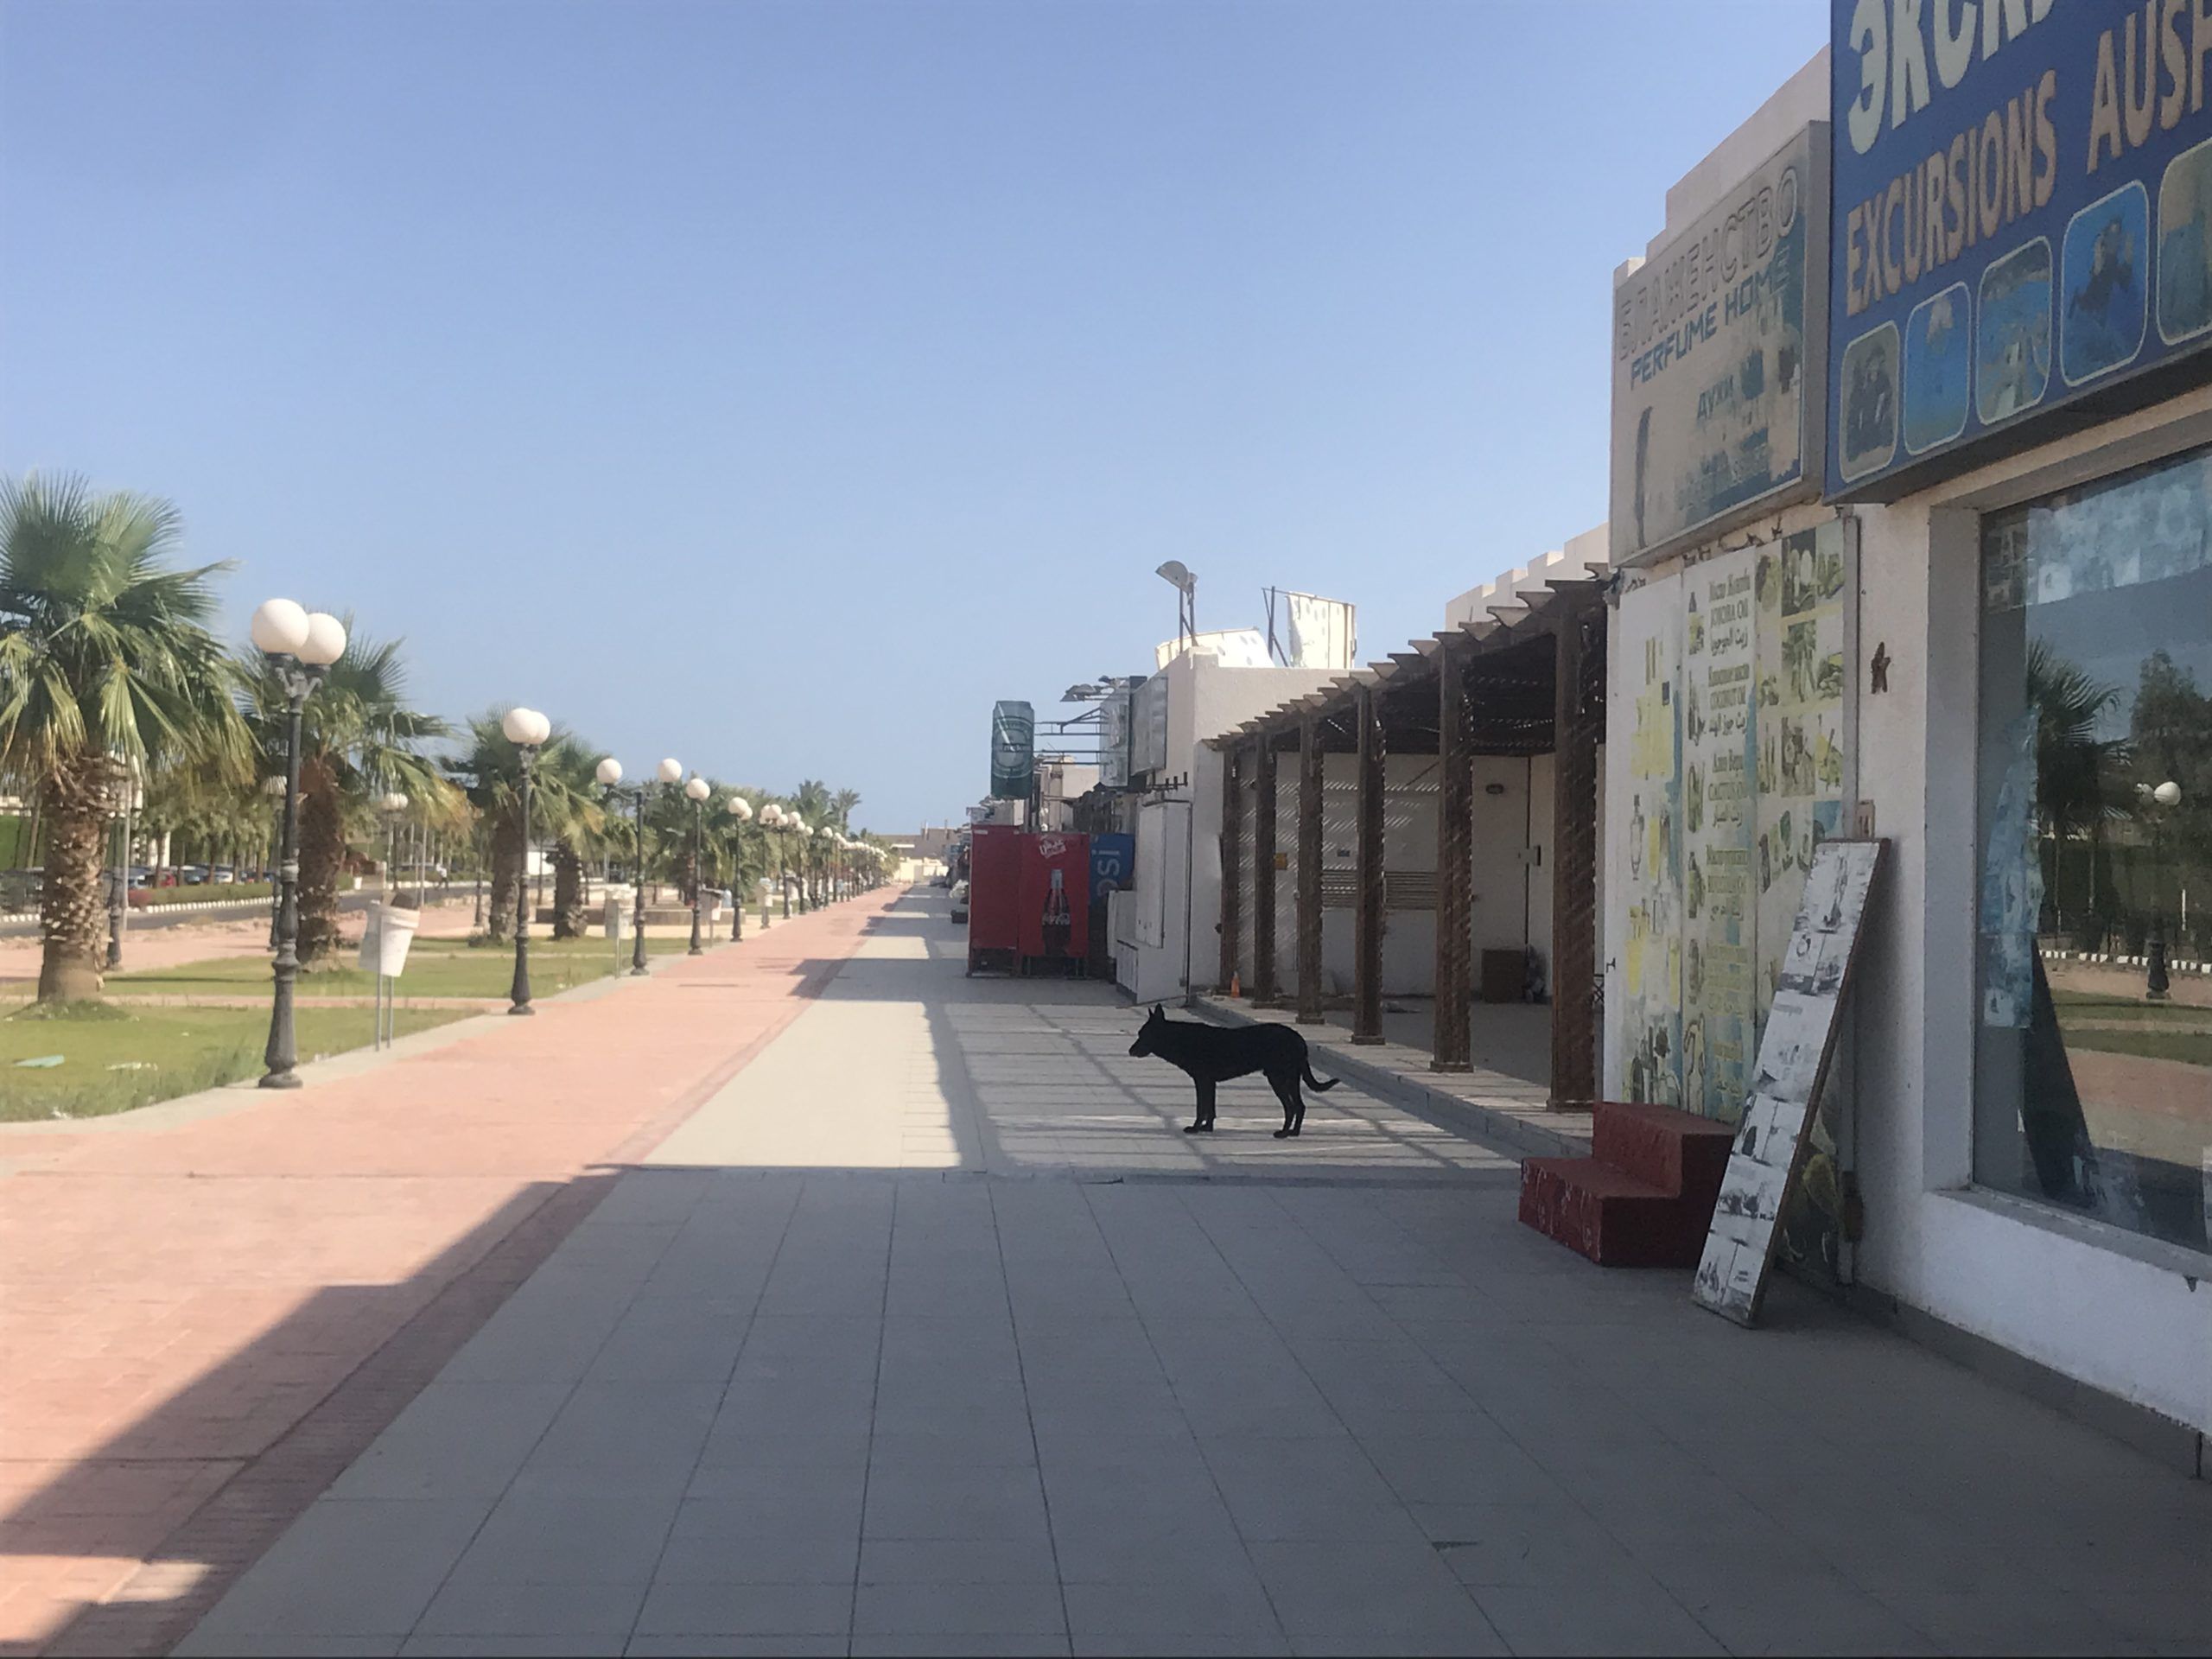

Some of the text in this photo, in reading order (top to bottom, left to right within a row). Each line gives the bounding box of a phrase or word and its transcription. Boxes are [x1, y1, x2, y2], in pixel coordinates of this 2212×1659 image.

[1847, 0, 2056, 154] ЭКС
[1846, 68, 2056, 316] EXCURSIONS
[1630, 243, 1790, 391] PERFUME HOME
